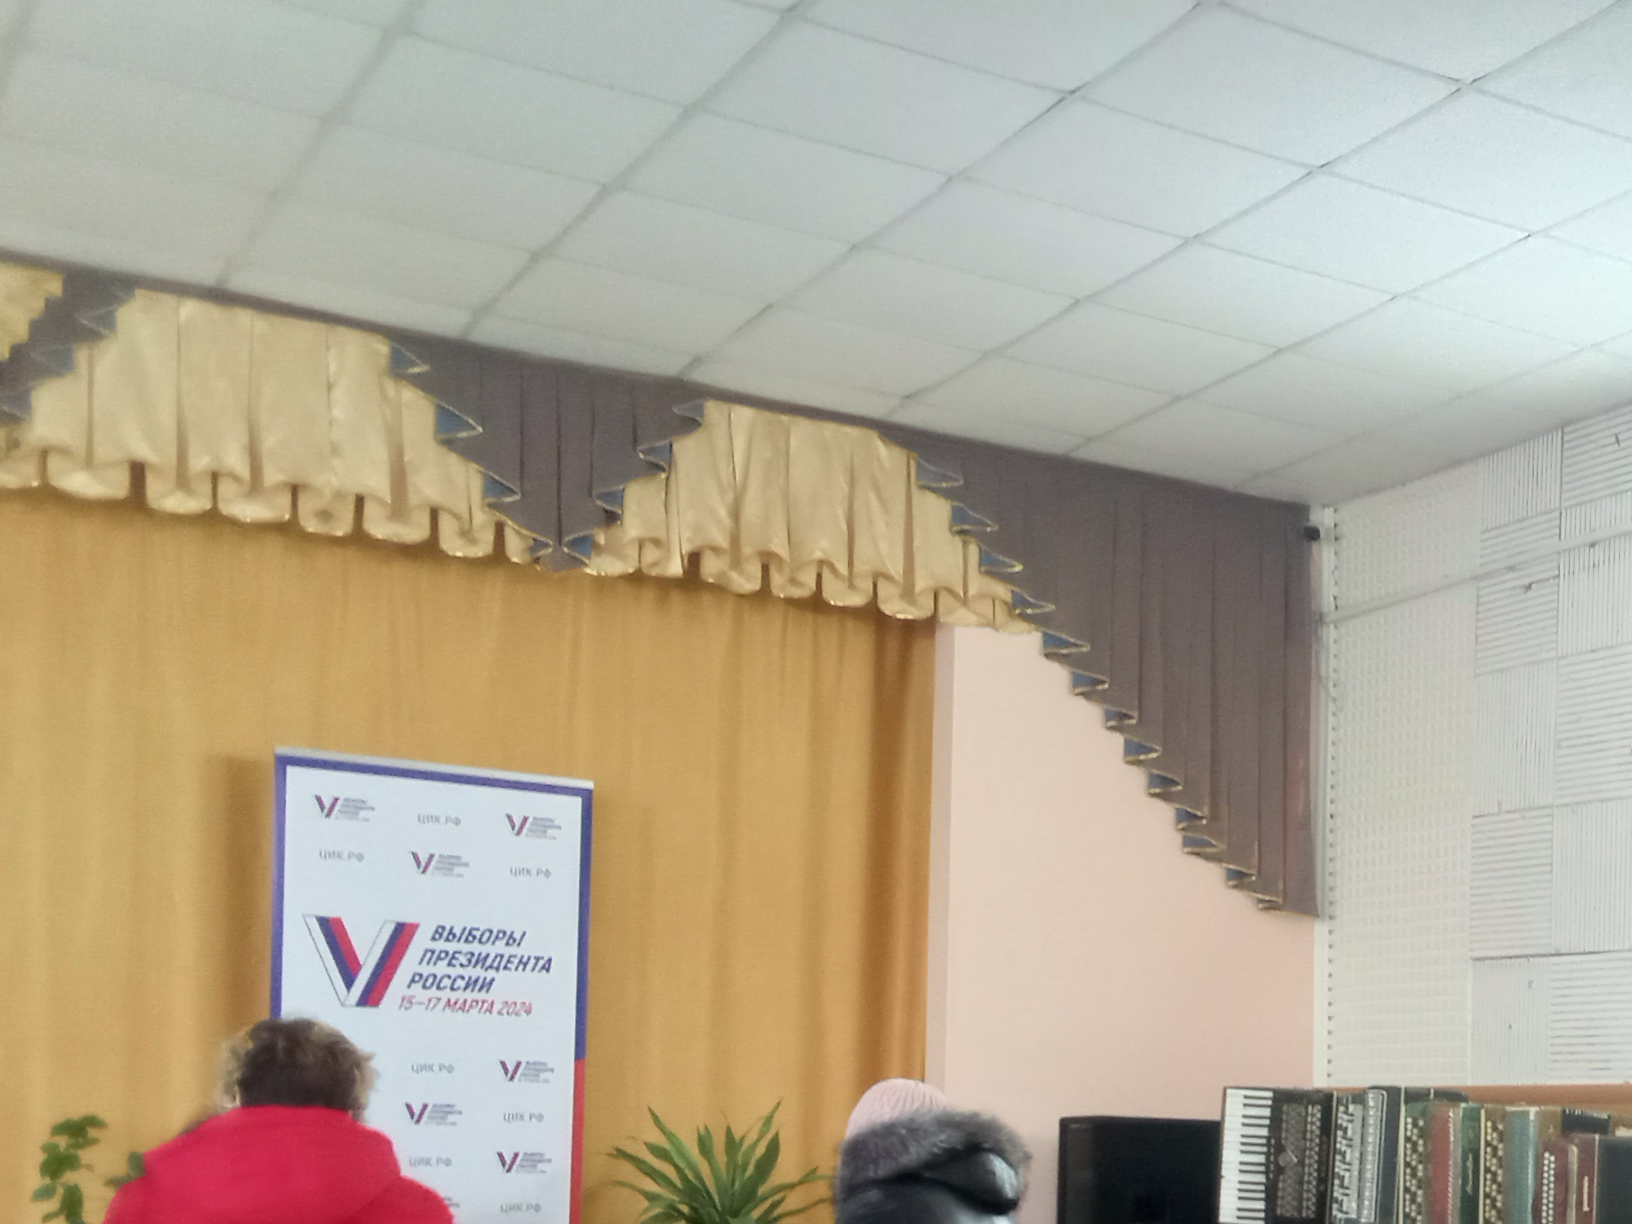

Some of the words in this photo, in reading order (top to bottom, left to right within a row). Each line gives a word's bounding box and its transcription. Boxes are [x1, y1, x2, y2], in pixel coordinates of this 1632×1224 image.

[430, 924, 527, 948] ВЫБОРЫ
[417, 948, 553, 974] ПРЕЗИДЕНТА
[406, 971, 496, 994] РОССИИ
[442, 997, 495, 1015] МАРТА
[496, 1000, 533, 1017] 2024
